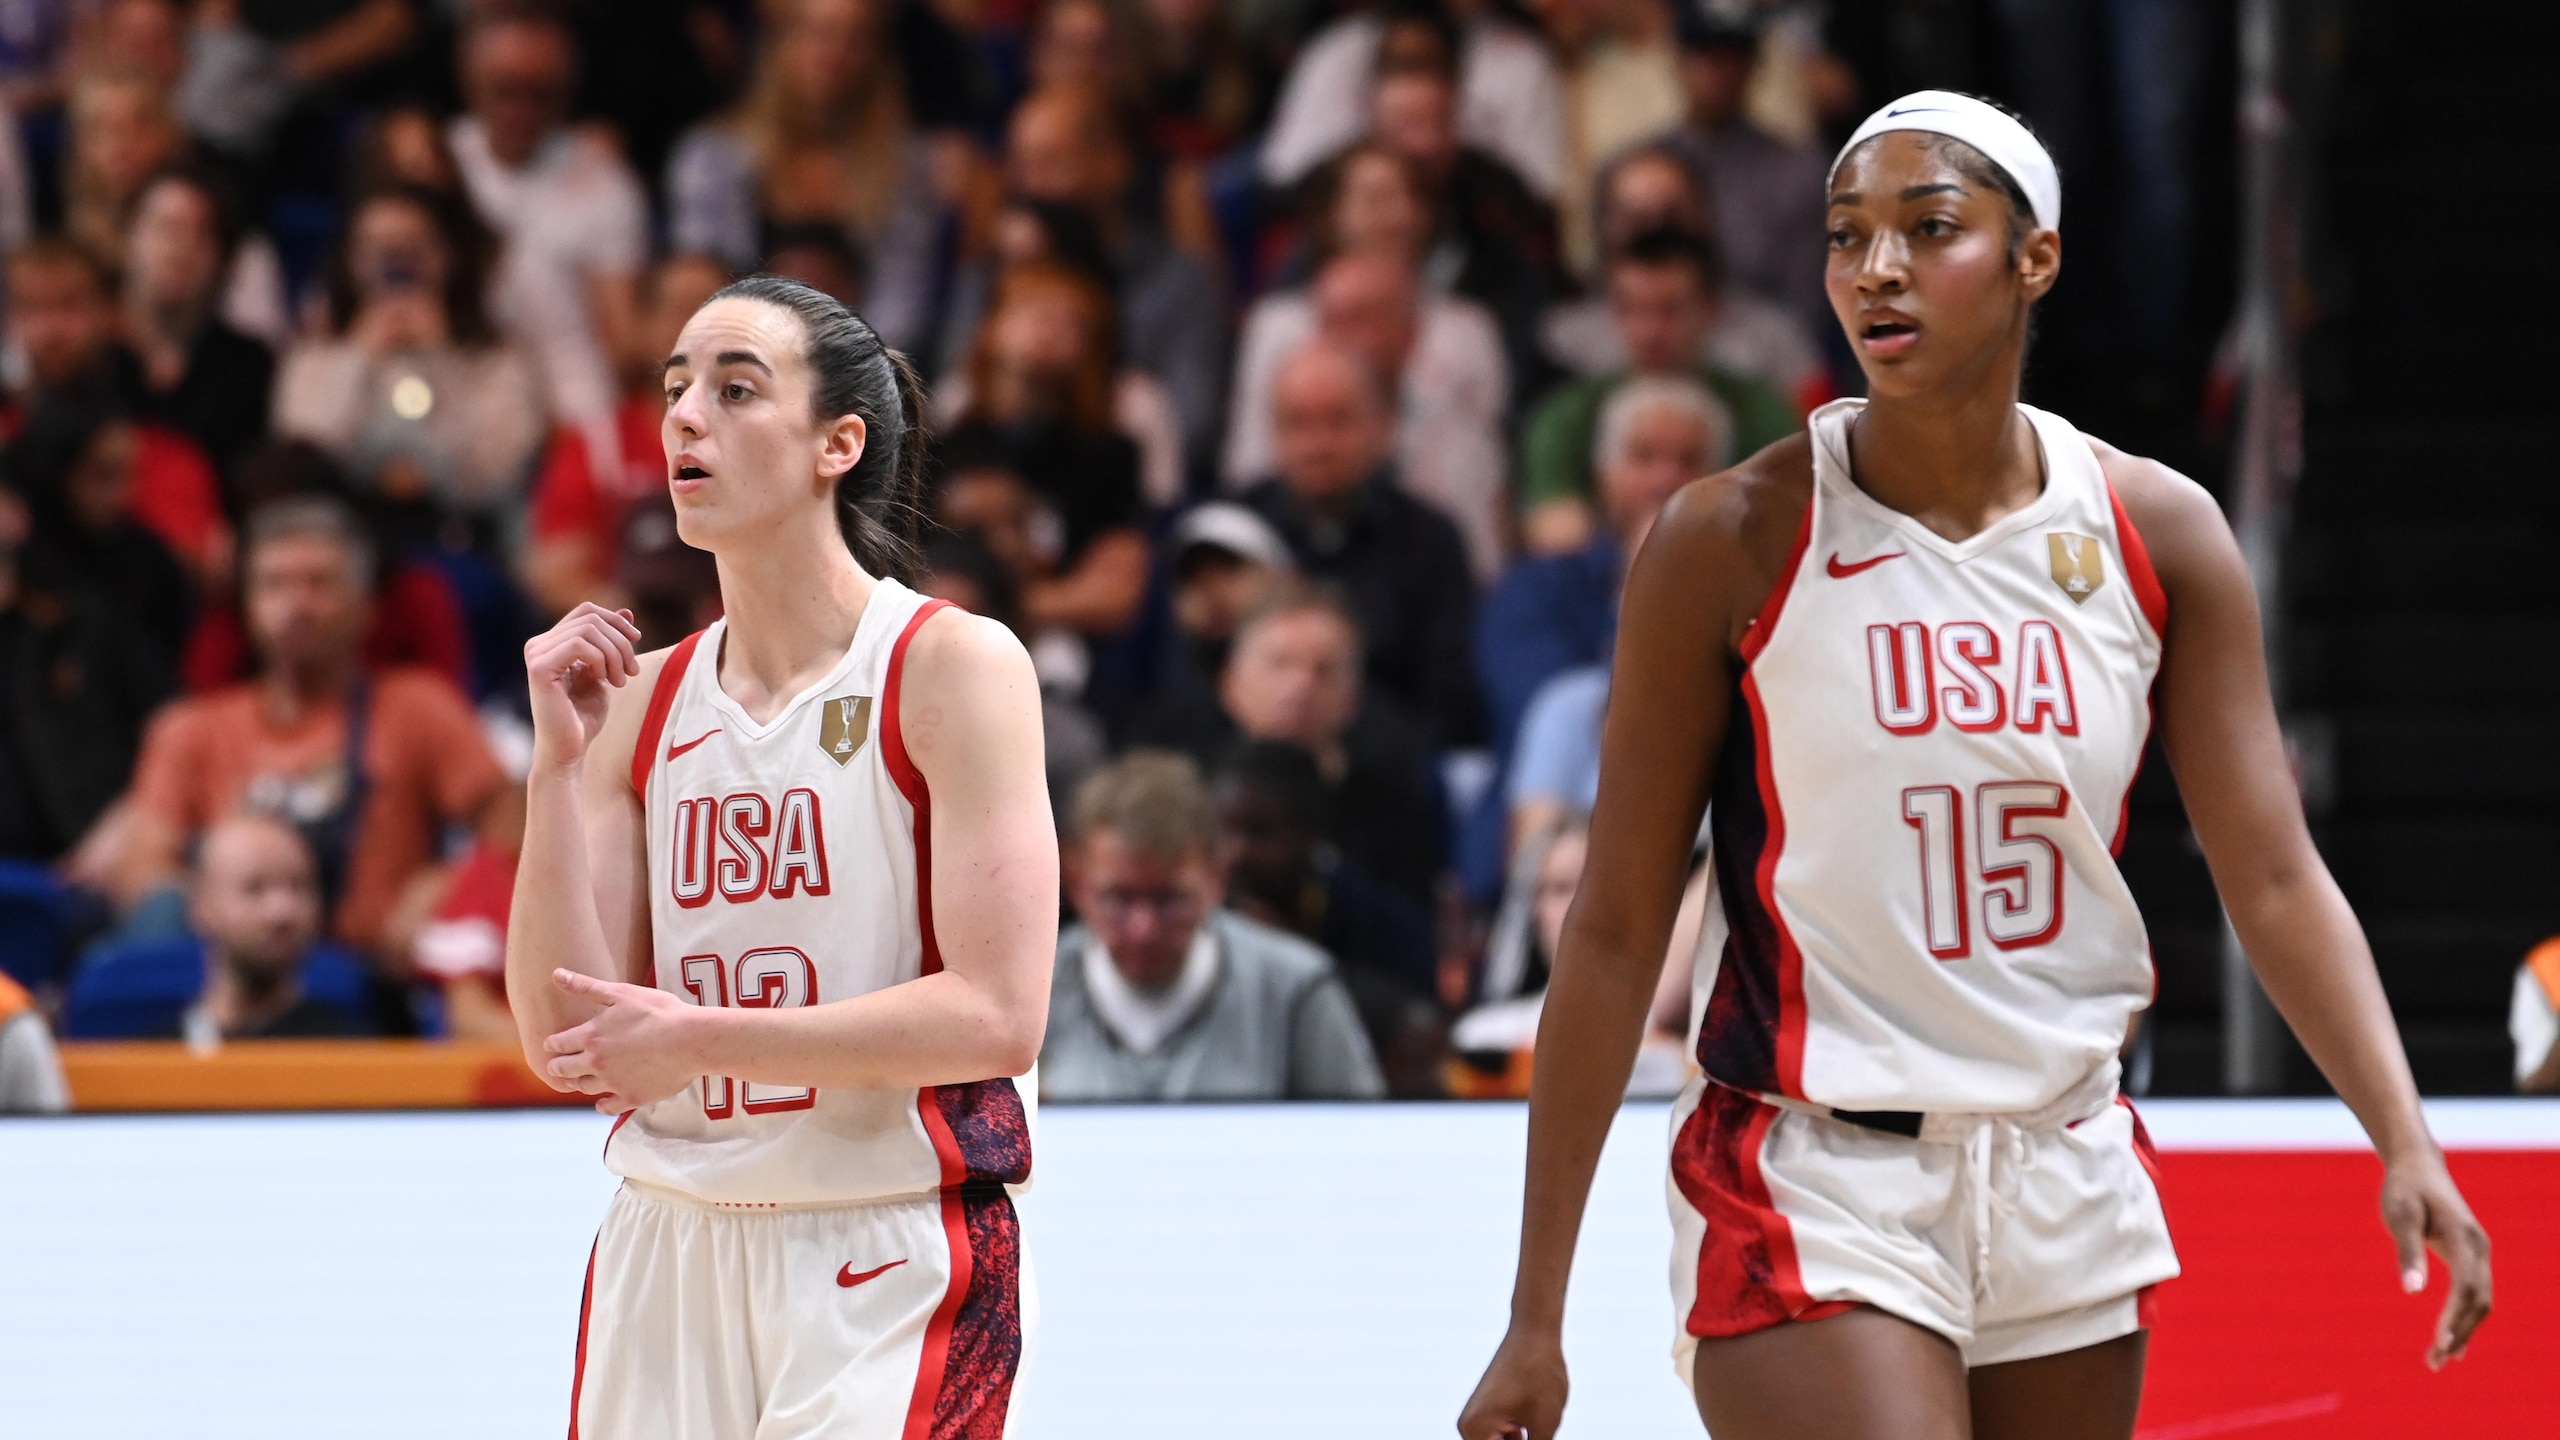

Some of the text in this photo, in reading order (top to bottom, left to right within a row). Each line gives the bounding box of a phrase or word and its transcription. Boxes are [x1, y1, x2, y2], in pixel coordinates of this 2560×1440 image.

[1867, 620, 2080, 736] USA
[672, 788, 831, 909] USA
[1902, 780, 2070, 960] 15
[681, 946, 818, 1120] 12
